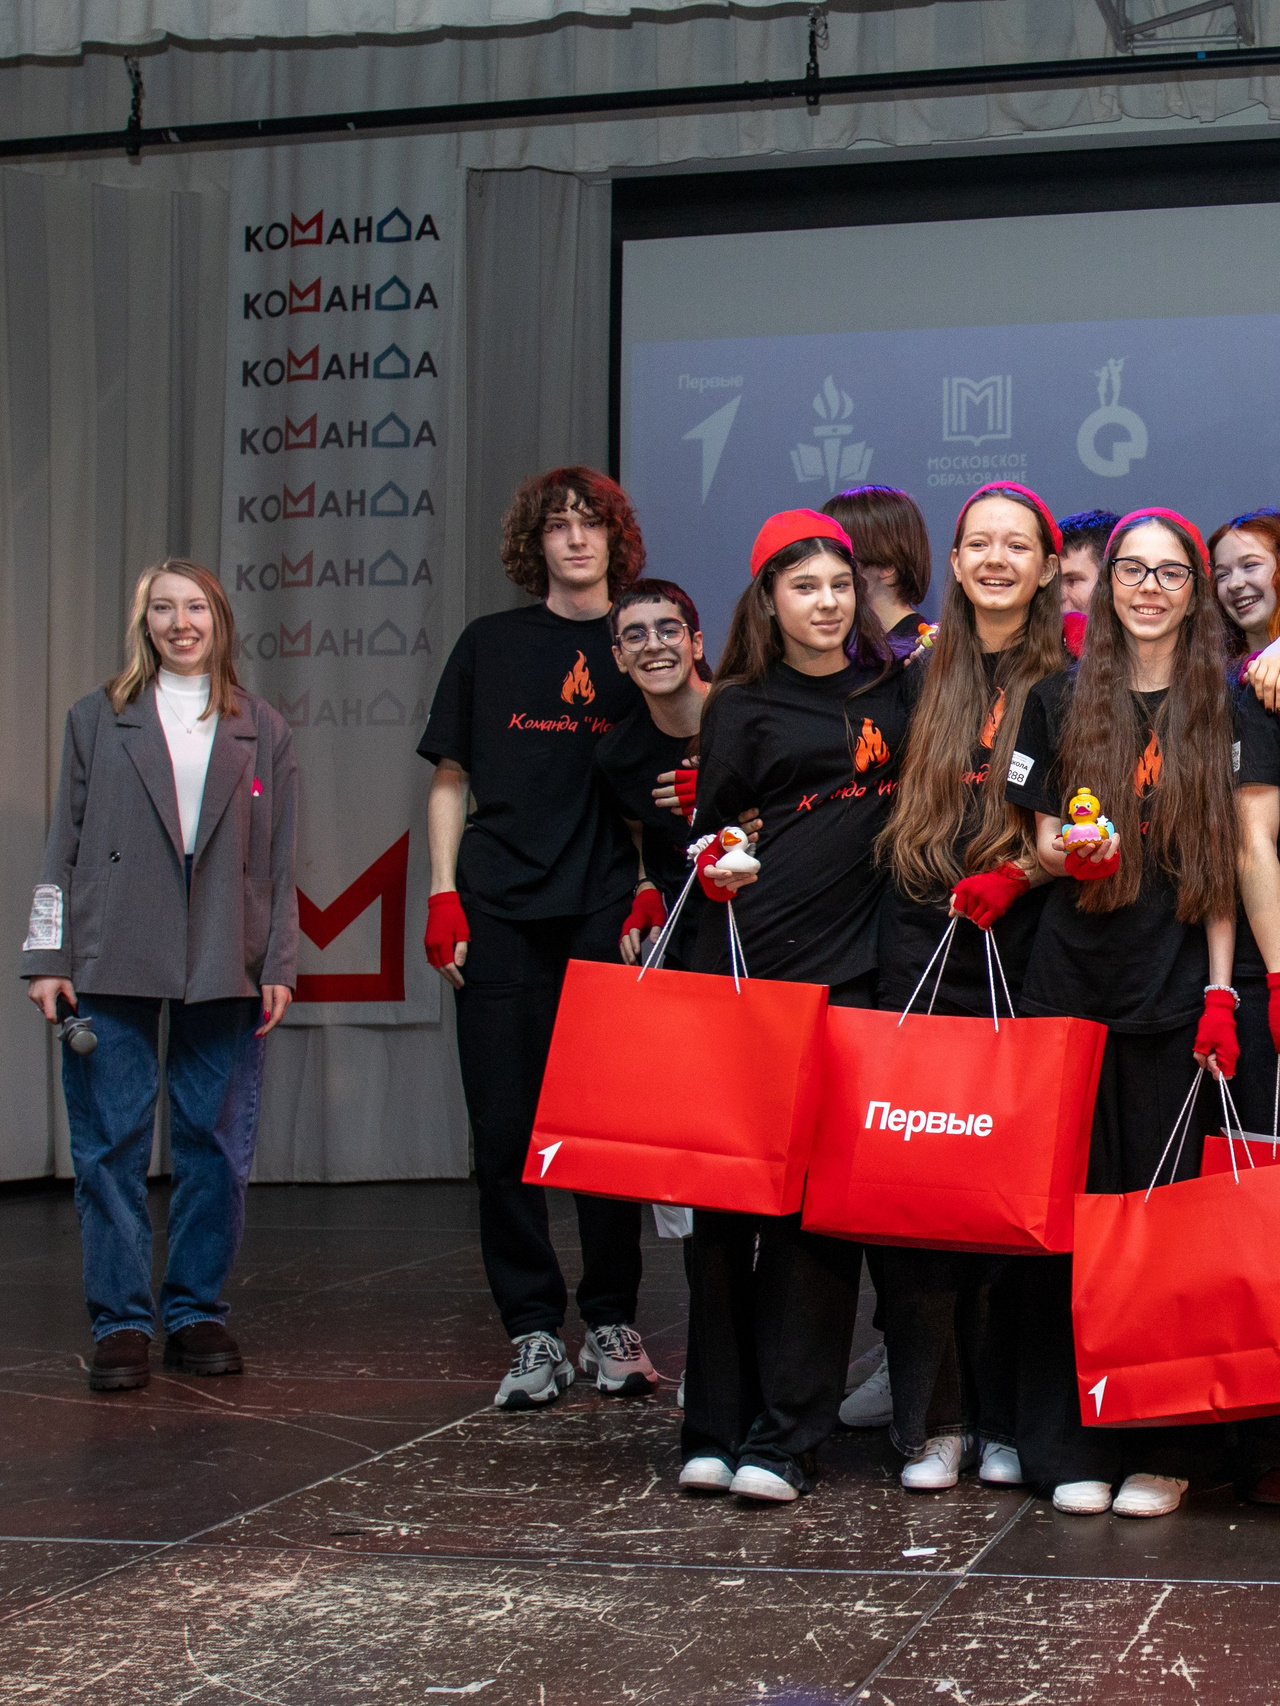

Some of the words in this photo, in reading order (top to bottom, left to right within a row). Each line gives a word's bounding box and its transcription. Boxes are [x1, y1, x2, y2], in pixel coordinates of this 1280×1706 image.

[679, 375, 744, 394] Первые
[927, 453, 1028, 471] МОСКОВСКОЕ
[508, 712, 580, 733] Команда
[864, 1100, 994, 1142] Первые
